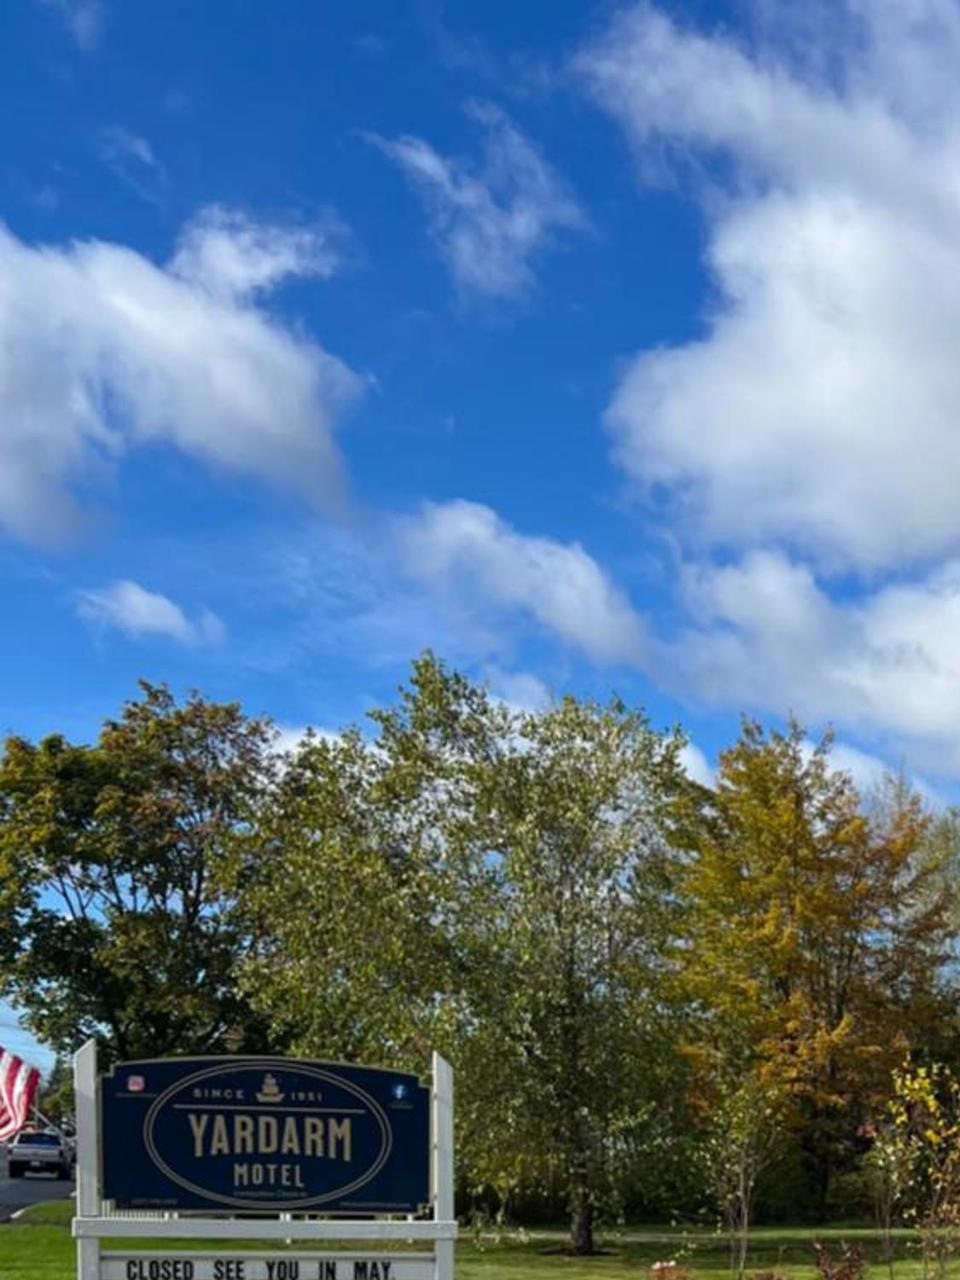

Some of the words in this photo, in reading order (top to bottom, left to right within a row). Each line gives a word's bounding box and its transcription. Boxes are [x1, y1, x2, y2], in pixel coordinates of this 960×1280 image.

[192, 1087, 244, 1099] SINCE
[187, 1114, 352, 1162] YARDARM
[233, 1162, 305, 1188] MOTEL
[126, 1259, 195, 1280] CLOSED
[213, 1260, 245, 1280] SEE
[265, 1260, 299, 1280] YOU
[318, 1261, 336, 1280] IN
